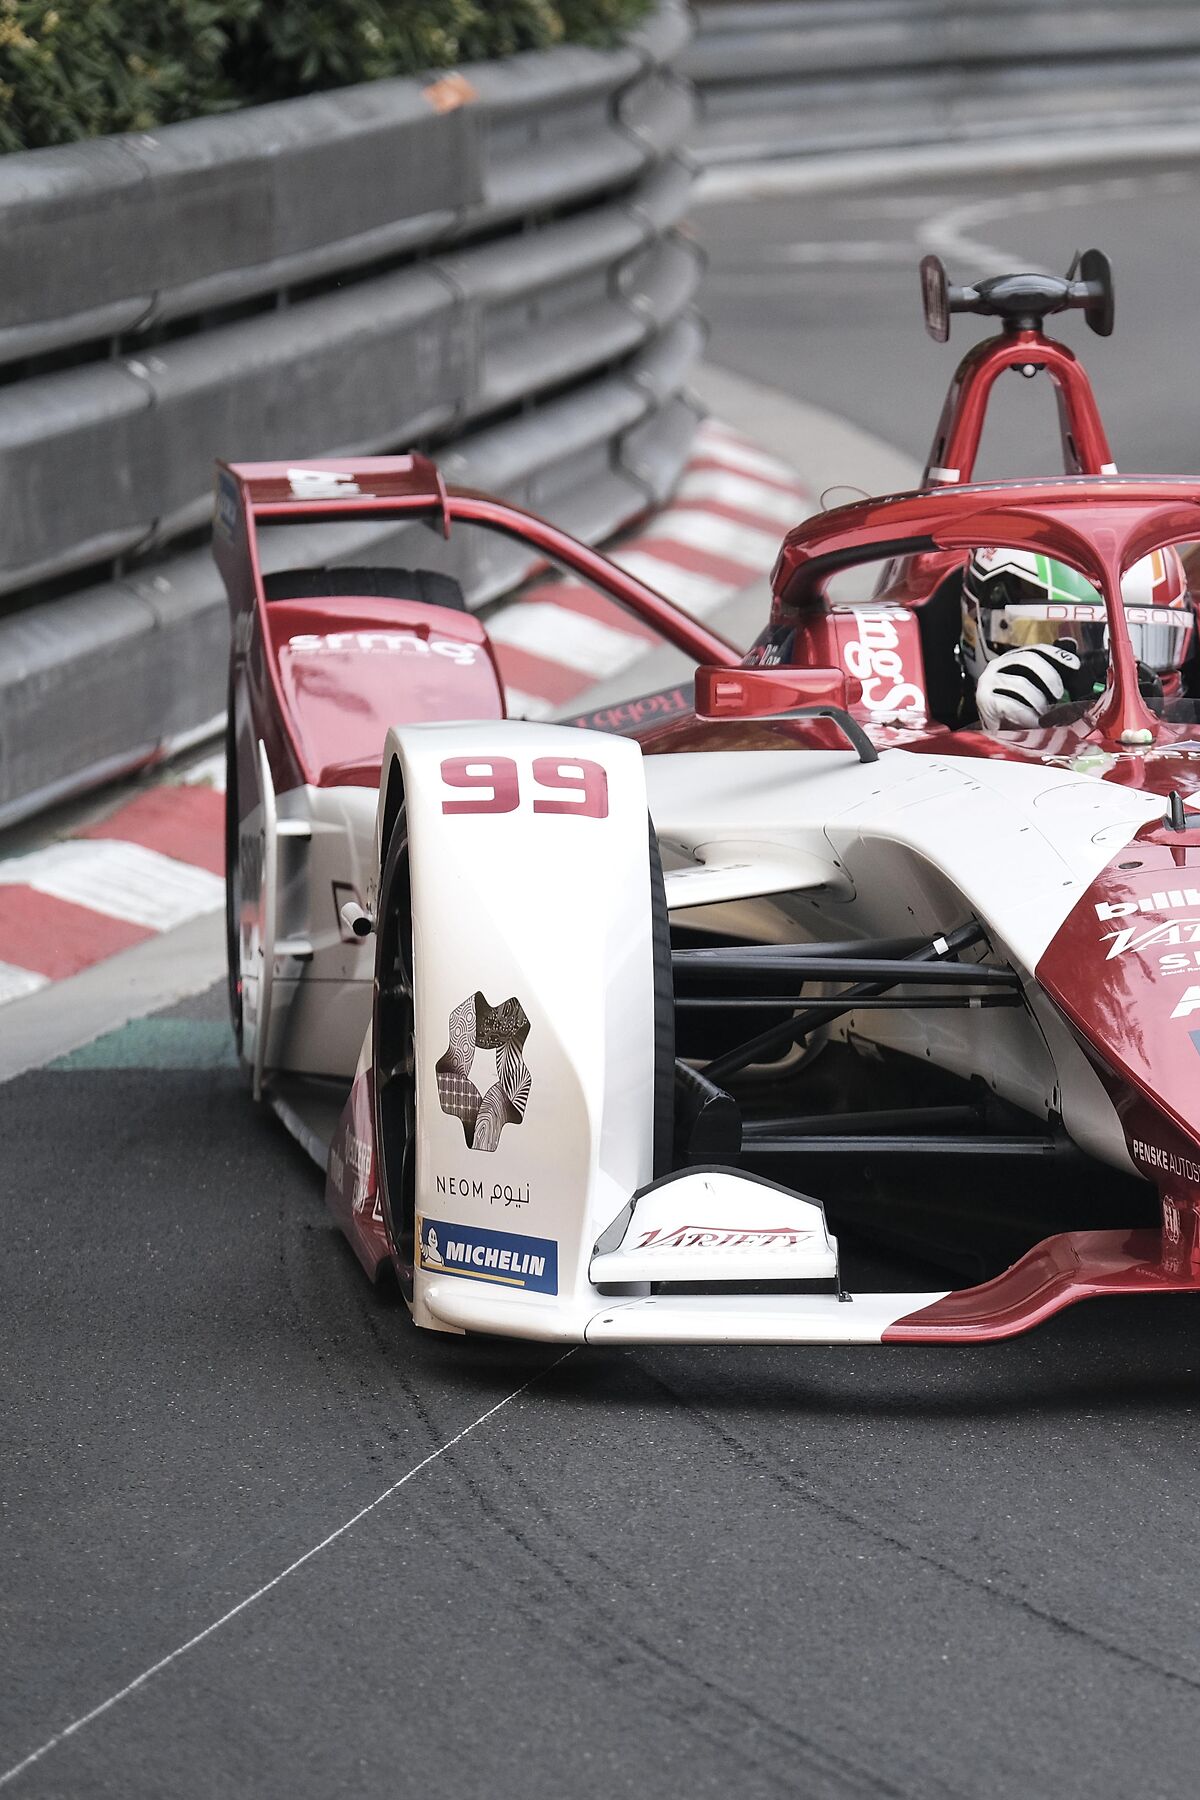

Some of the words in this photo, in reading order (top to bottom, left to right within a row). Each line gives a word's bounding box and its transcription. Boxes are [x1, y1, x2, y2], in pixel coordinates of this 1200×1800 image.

[1046, 605, 1186, 626] DRGON
[288, 633, 481, 666] srmg
[440, 756, 609, 819] 99
[1133, 1139, 1168, 1170] PENSKE
[436, 1175, 483, 1199] NEOM
[631, 1225, 816, 1251] VARIETY
[445, 1240, 546, 1277] MICHELIN
